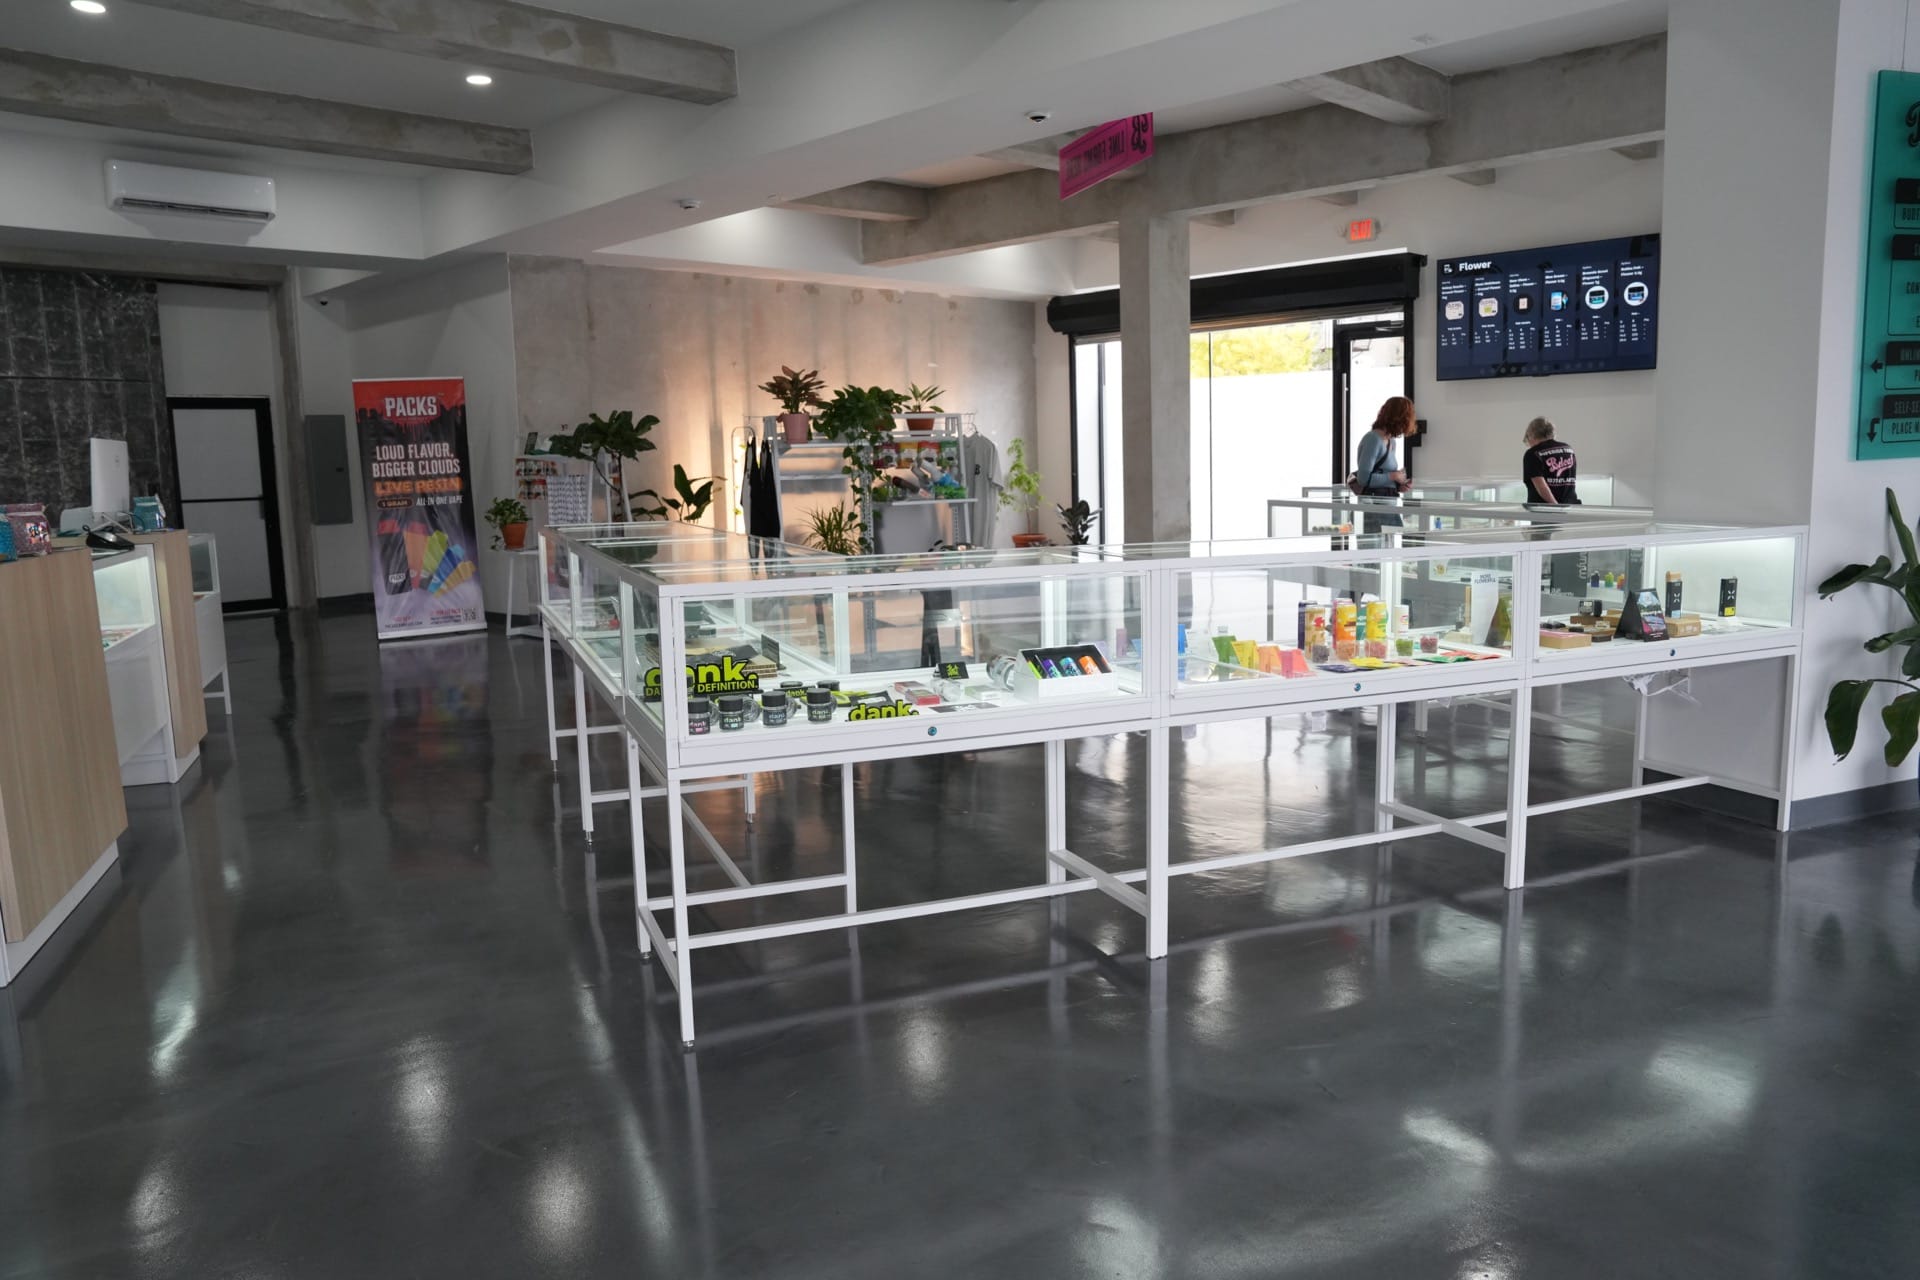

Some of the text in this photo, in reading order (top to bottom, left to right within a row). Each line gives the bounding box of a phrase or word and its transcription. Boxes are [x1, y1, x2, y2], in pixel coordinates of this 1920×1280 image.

[1350, 218, 1372, 241] EXIT
[1458, 261, 1492, 273] Flower
[384, 395, 438, 418] PACKS
[375, 444, 405, 461] LOUD
[372, 458, 461, 478] BIGGER CLOUDS
[375, 476, 463, 496] LIVE RESIN
[697, 680, 759, 693] DEFINITION.
[850, 700, 920, 722] dank.
